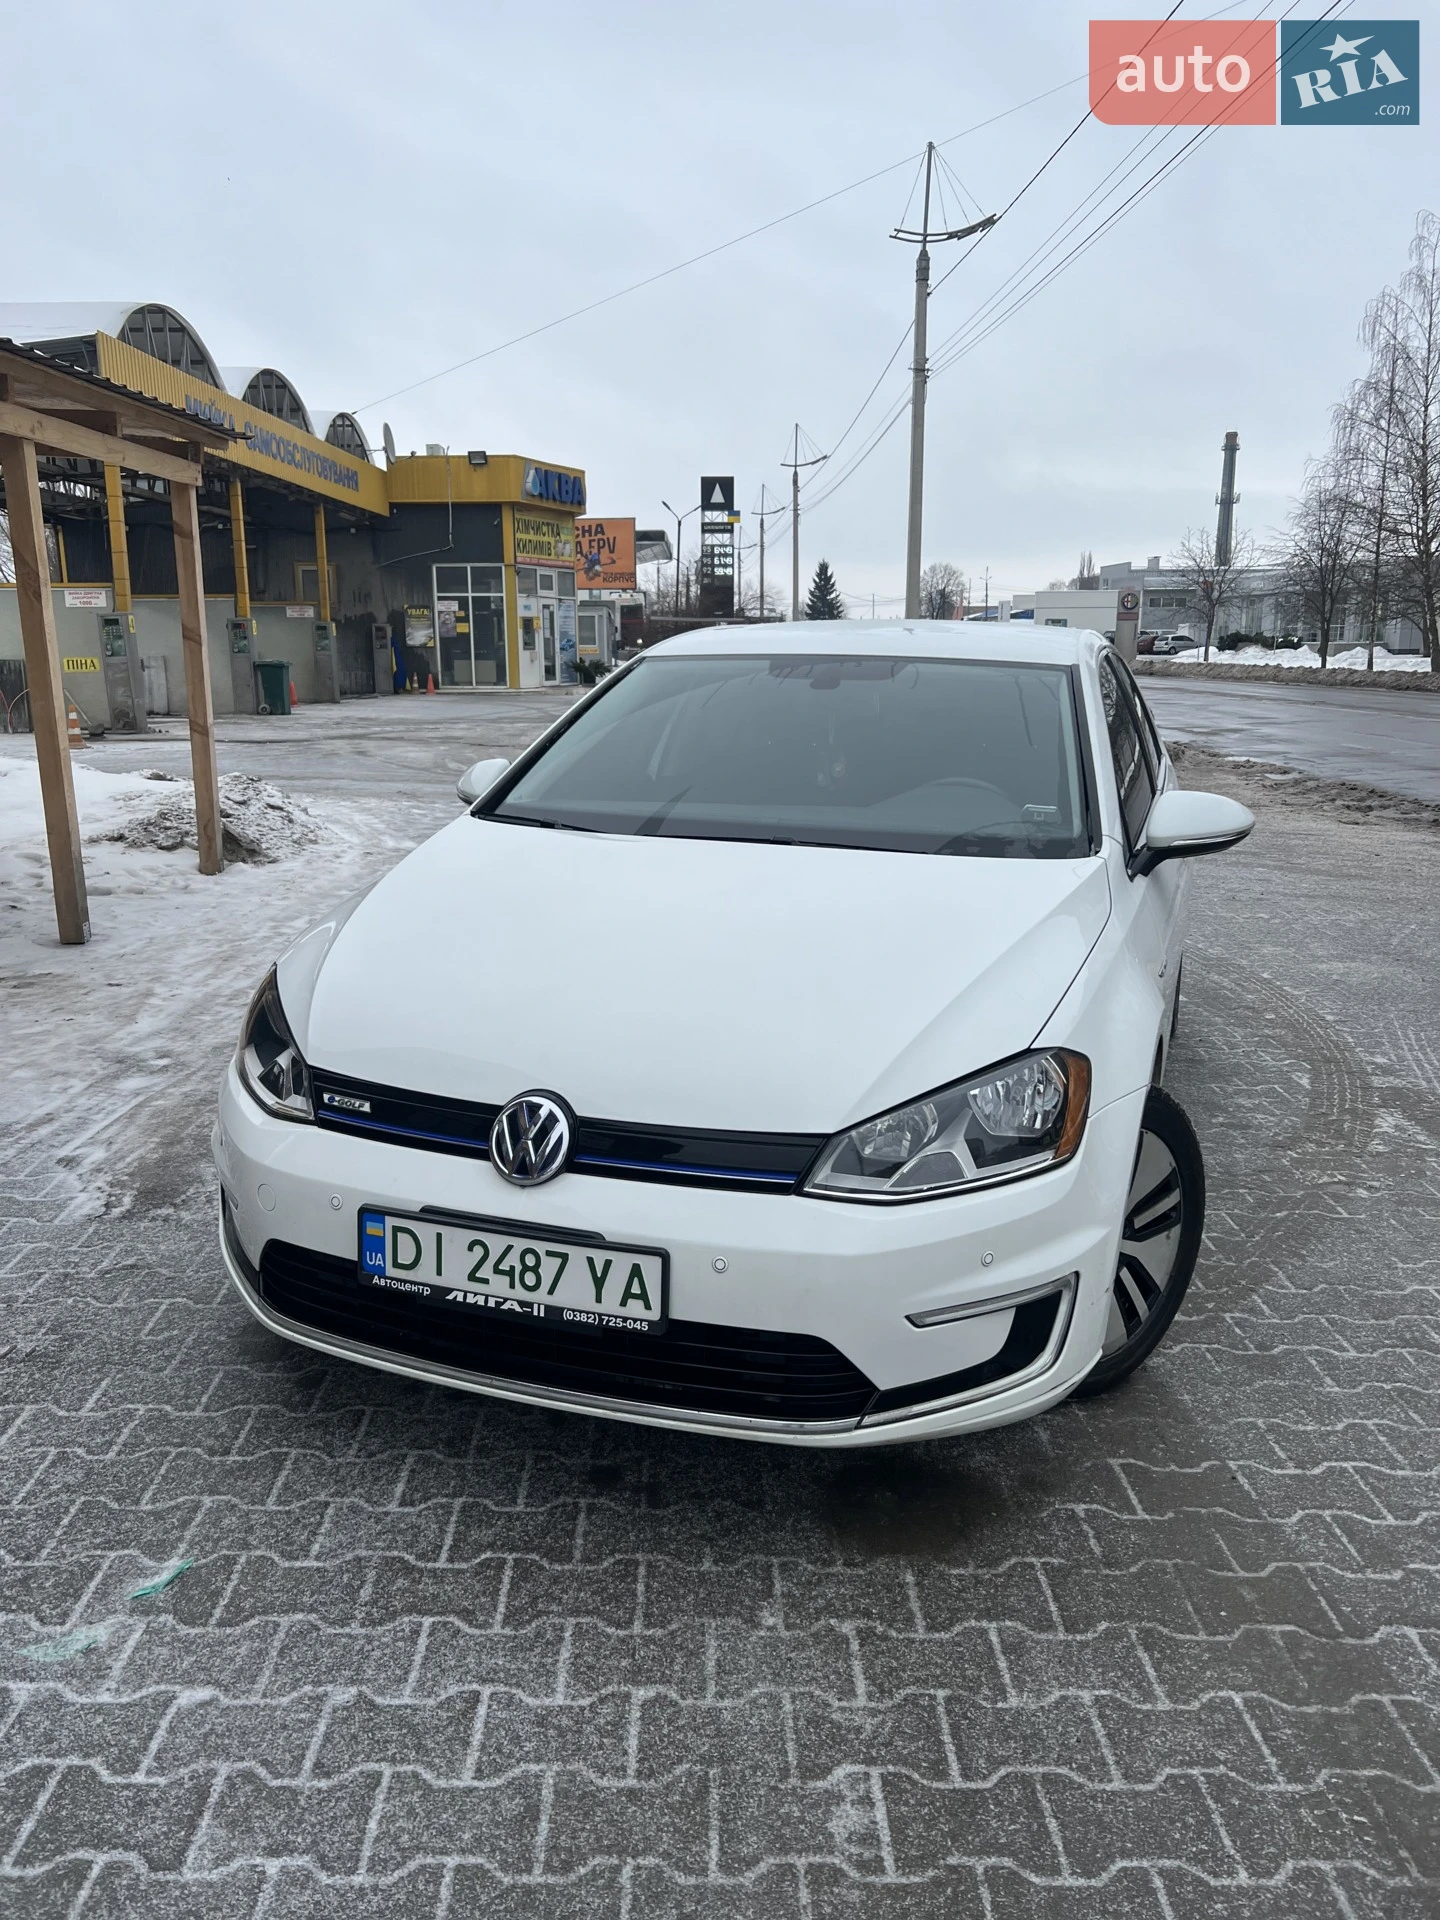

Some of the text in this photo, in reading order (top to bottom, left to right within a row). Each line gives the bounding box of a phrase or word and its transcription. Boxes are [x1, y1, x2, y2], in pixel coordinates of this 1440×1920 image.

[243, 420, 359, 492] САМООБСЛУГОВУВАННЯ
[534, 467, 585, 505] АКВА
[516, 518, 561, 539] ХІМЧИСТКА
[517, 538, 552, 557] КИЛИМІВ
[588, 536, 617, 556] FPV
[66, 659, 97, 670] ПІНА
[366, 1250, 385, 1268] UA
[391, 1224, 653, 1312] DI 2487 YA
[372, 1274, 431, 1296] Автоцентр
[563, 1308, 599, 1325] (0382)
[601, 1315, 649, 1331] 725-045
